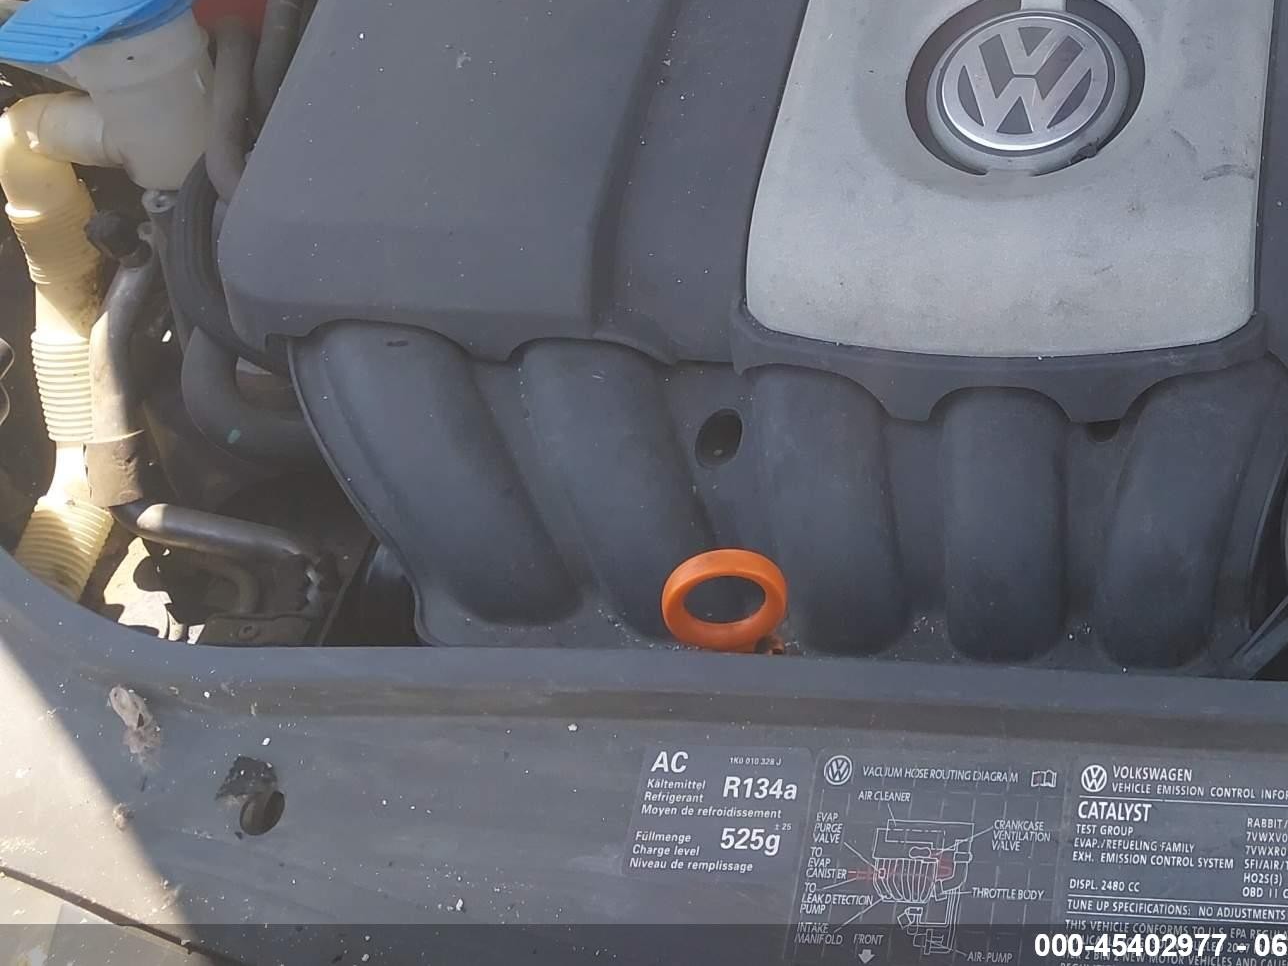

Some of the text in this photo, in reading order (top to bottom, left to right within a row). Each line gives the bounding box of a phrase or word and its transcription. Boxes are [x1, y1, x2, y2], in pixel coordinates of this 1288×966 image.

[650, 751, 689, 773] AC
[863, 766, 1018, 782] VACUUM HOSE ROUTING DIAGRAM
[1112, 765, 1192, 782] VOLKSWAGEN
[647, 778, 706, 790] Kältemittel
[722, 776, 798, 800] R134a
[858, 790, 910, 802] AIR CLEANER
[1112, 782, 1150, 794] VEHICLE
[1156, 784, 1204, 796] EMISSION
[1210, 786, 1256, 799] CONTROL
[644, 792, 704, 804] Refrigerant
[641, 804, 782, 818] Moyen de refroidissement
[816, 812, 838, 822] EVAP
[1078, 800, 1152, 822] CATALYST
[814, 823, 843, 834] PURGE
[994, 820, 1044, 832] CRANKCASE
[1076, 824, 1134, 836] TEST GROUP
[635, 830, 692, 842] Füllmenge
[720, 828, 781, 856] 525g
[813, 833, 840, 844] VALVE
[992, 830, 1051, 842] VENTILATION
[632, 844, 700, 858] Charge level
[810, 846, 823, 857] TO
[992, 840, 1021, 852] VALVE
[1161, 841, 1196, 853] FAMILY
[629, 858, 754, 874] Niveau de remplissage
[808, 858, 831, 868] EVAP
[1072, 851, 1234, 869] EXH. EMISSION CONTROL SYSTEM
[806, 868, 848, 879] CANISTER
[804, 882, 816, 893] TO
[1069, 878, 1140, 892] DISPL. 2480 CC
[972, 887, 1045, 900] THROTTLE BODY
[1242, 886, 1264, 898] OBD
[802, 894, 874, 906] LEAK DETECTION
[800, 904, 826, 914] PUMP
[1067, 899, 1093, 911] TUNE
[1096, 901, 1110, 912] UP
[1112, 902, 1191, 916] SPECIFICATIONS:
[1198, 906, 1214, 917] NO
[1216, 906, 1286, 920] ADJUSTMENTS
[797, 922, 829, 934] INTAKE
[1065, 919, 1086, 930] THIS
[1090, 920, 1130, 933] VEHICLE
[1230, 928, 1247, 940] EPA
[794, 934, 843, 944] MANIFOLD
[854, 934, 884, 945] FRONT
